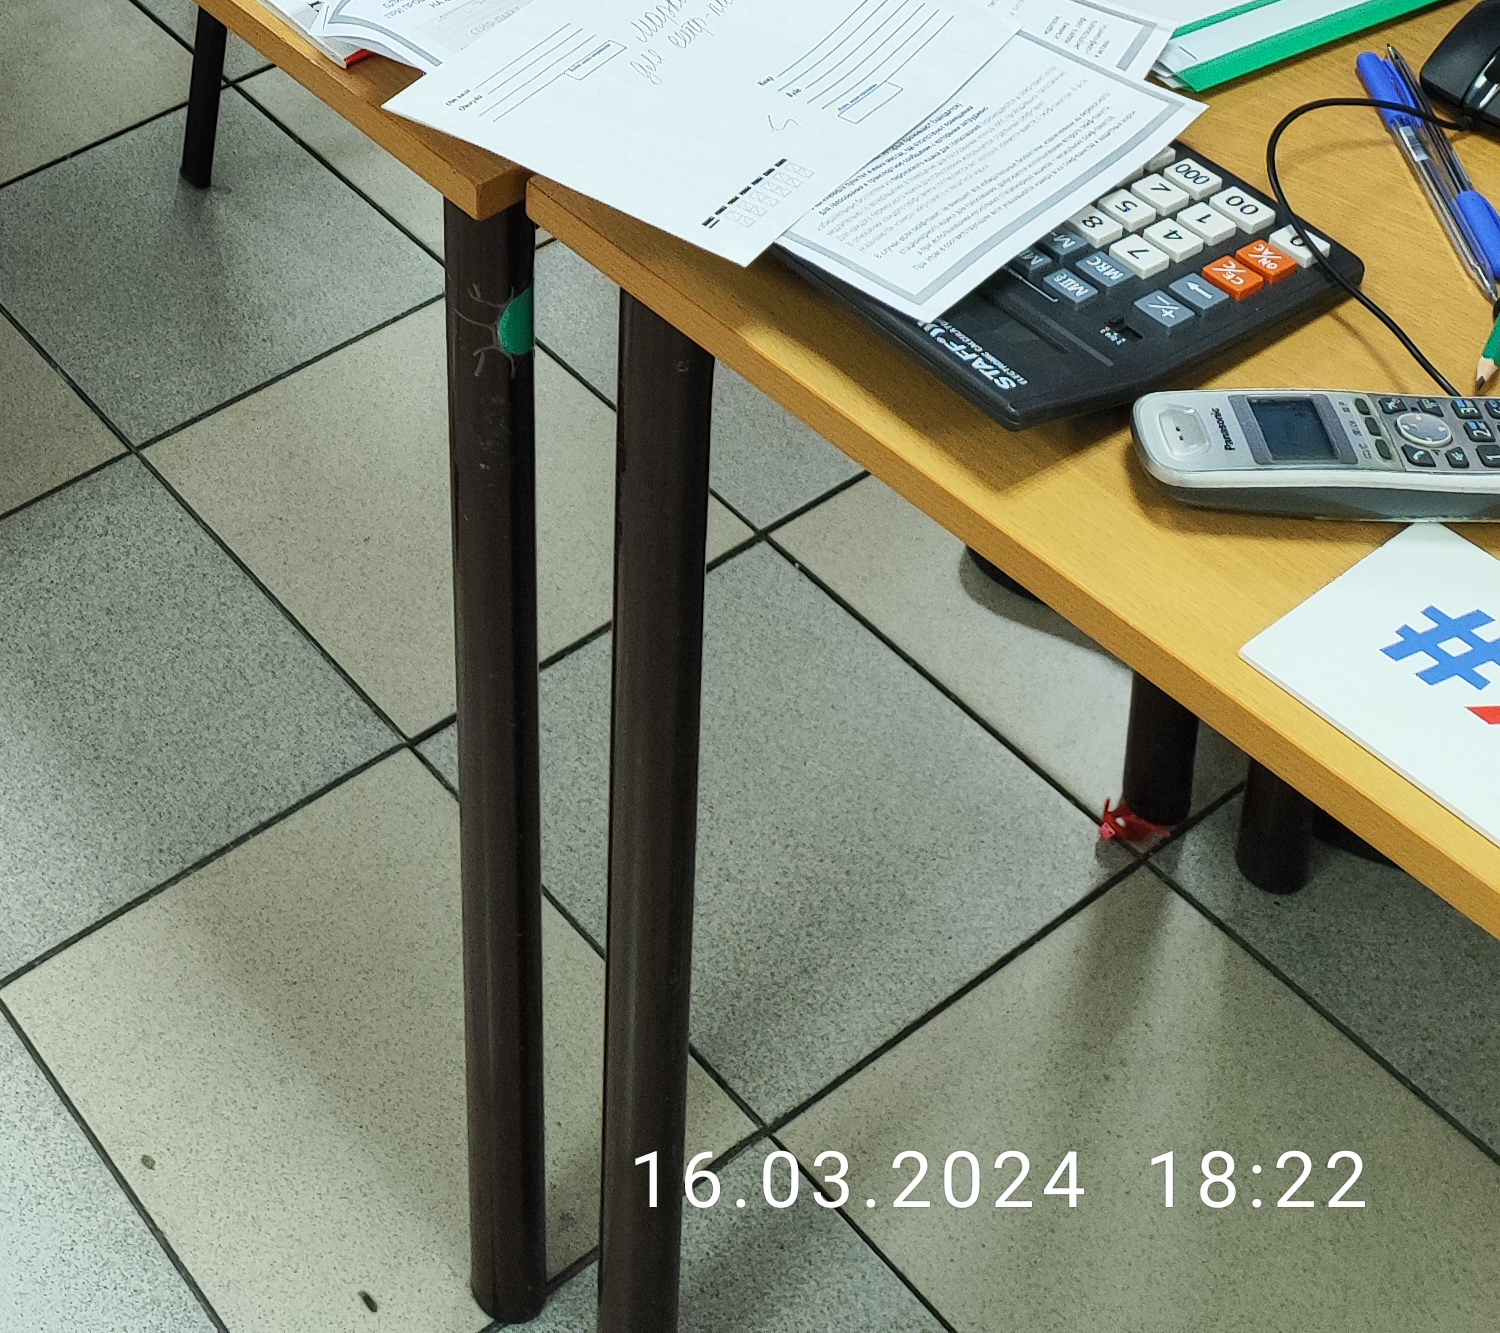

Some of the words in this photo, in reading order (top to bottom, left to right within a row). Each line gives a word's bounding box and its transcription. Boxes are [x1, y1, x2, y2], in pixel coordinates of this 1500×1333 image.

[1174, 162, 1211, 187] 000
[1116, 198, 1138, 215] 5
[1224, 194, 1261, 219] 00
[1081, 213, 1104, 231] 8
[1196, 212, 1213, 226] 1
[1162, 228, 1184, 245] 4
[1126, 243, 1146, 261] 7
[1087, 254, 1124, 282] MRC
[944, 337, 1017, 392] STAFF
[1211, 407, 1236, 451] Panasonic
